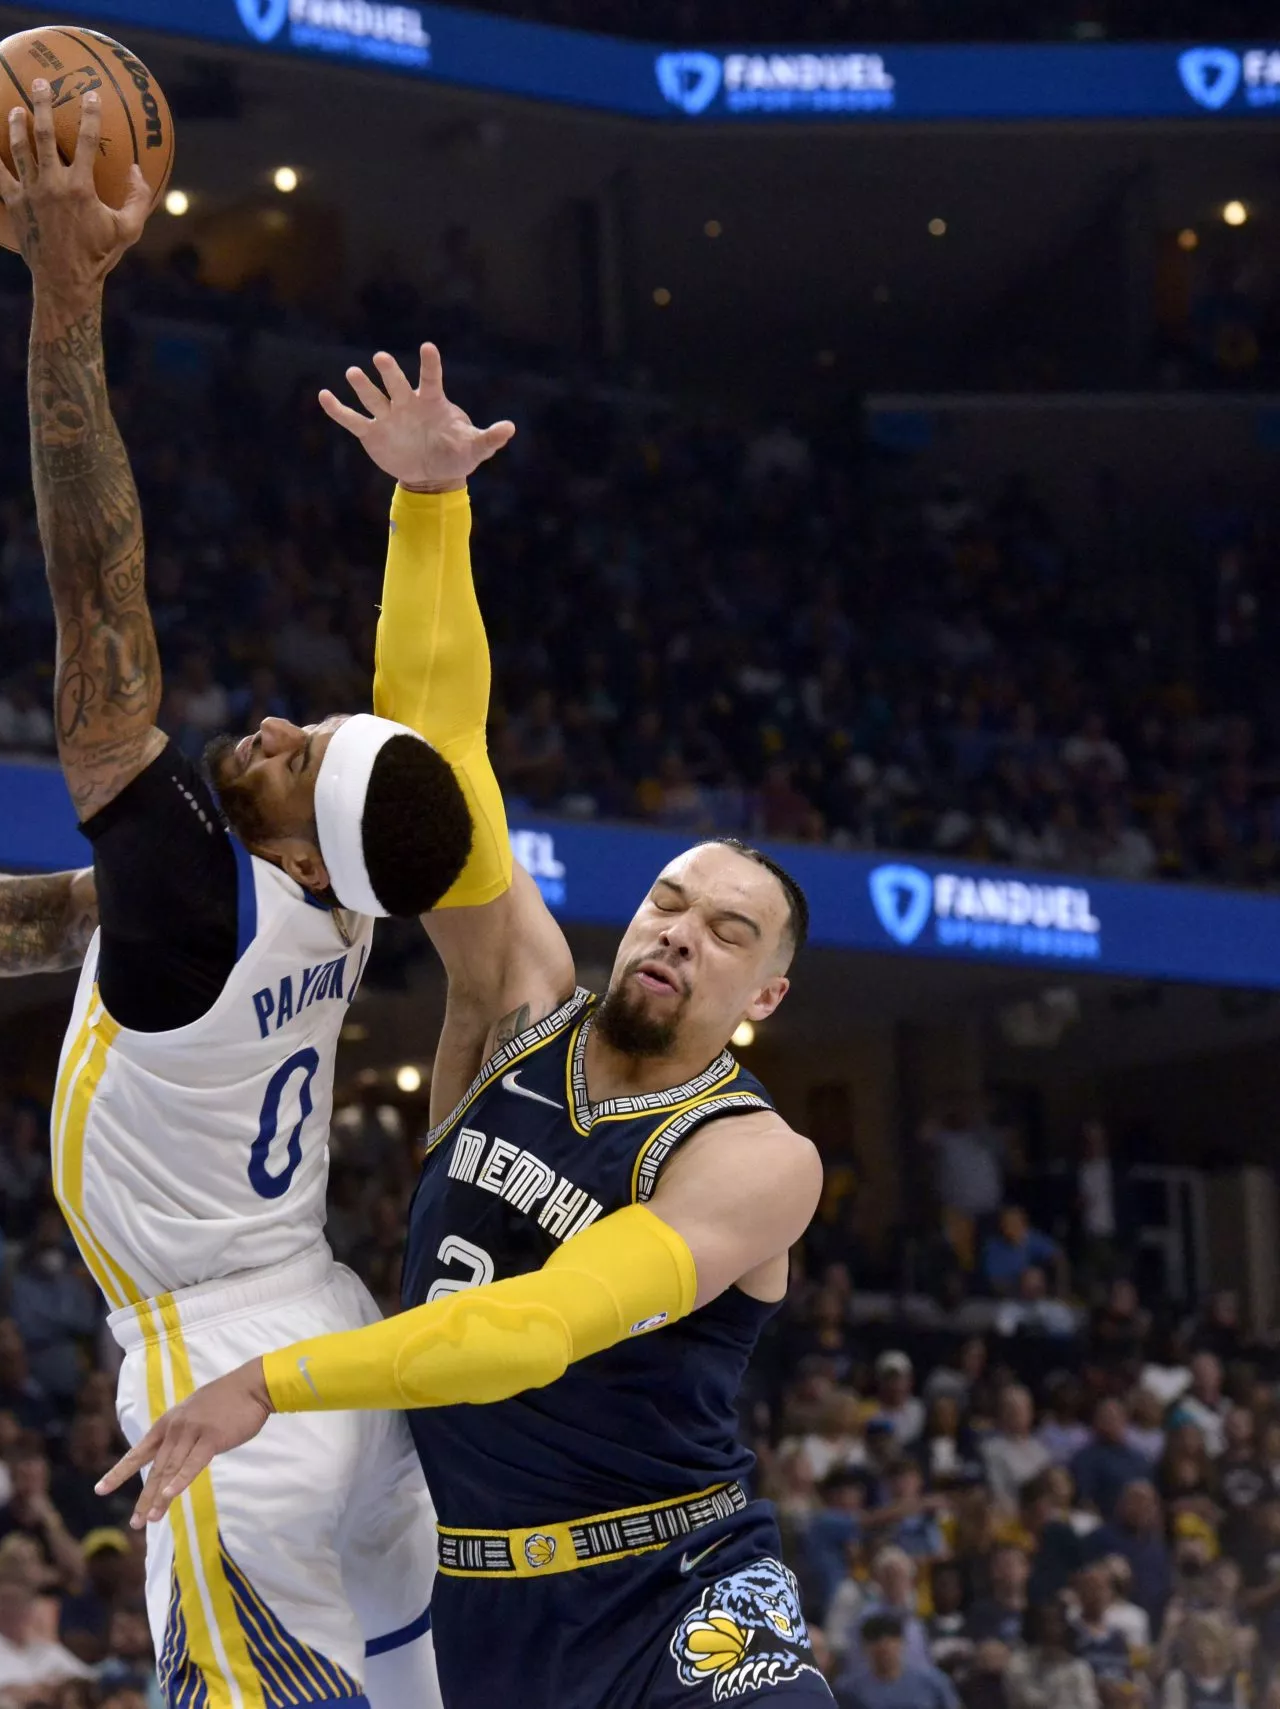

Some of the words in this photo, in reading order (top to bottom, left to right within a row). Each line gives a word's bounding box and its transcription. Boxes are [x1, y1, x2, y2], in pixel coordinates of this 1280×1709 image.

[934, 873, 1101, 933] FANDUEL
[252, 953, 348, 1039] PAYTON
[247, 1046, 320, 1200] 0
[448, 1127, 604, 1243] MEMPHI
